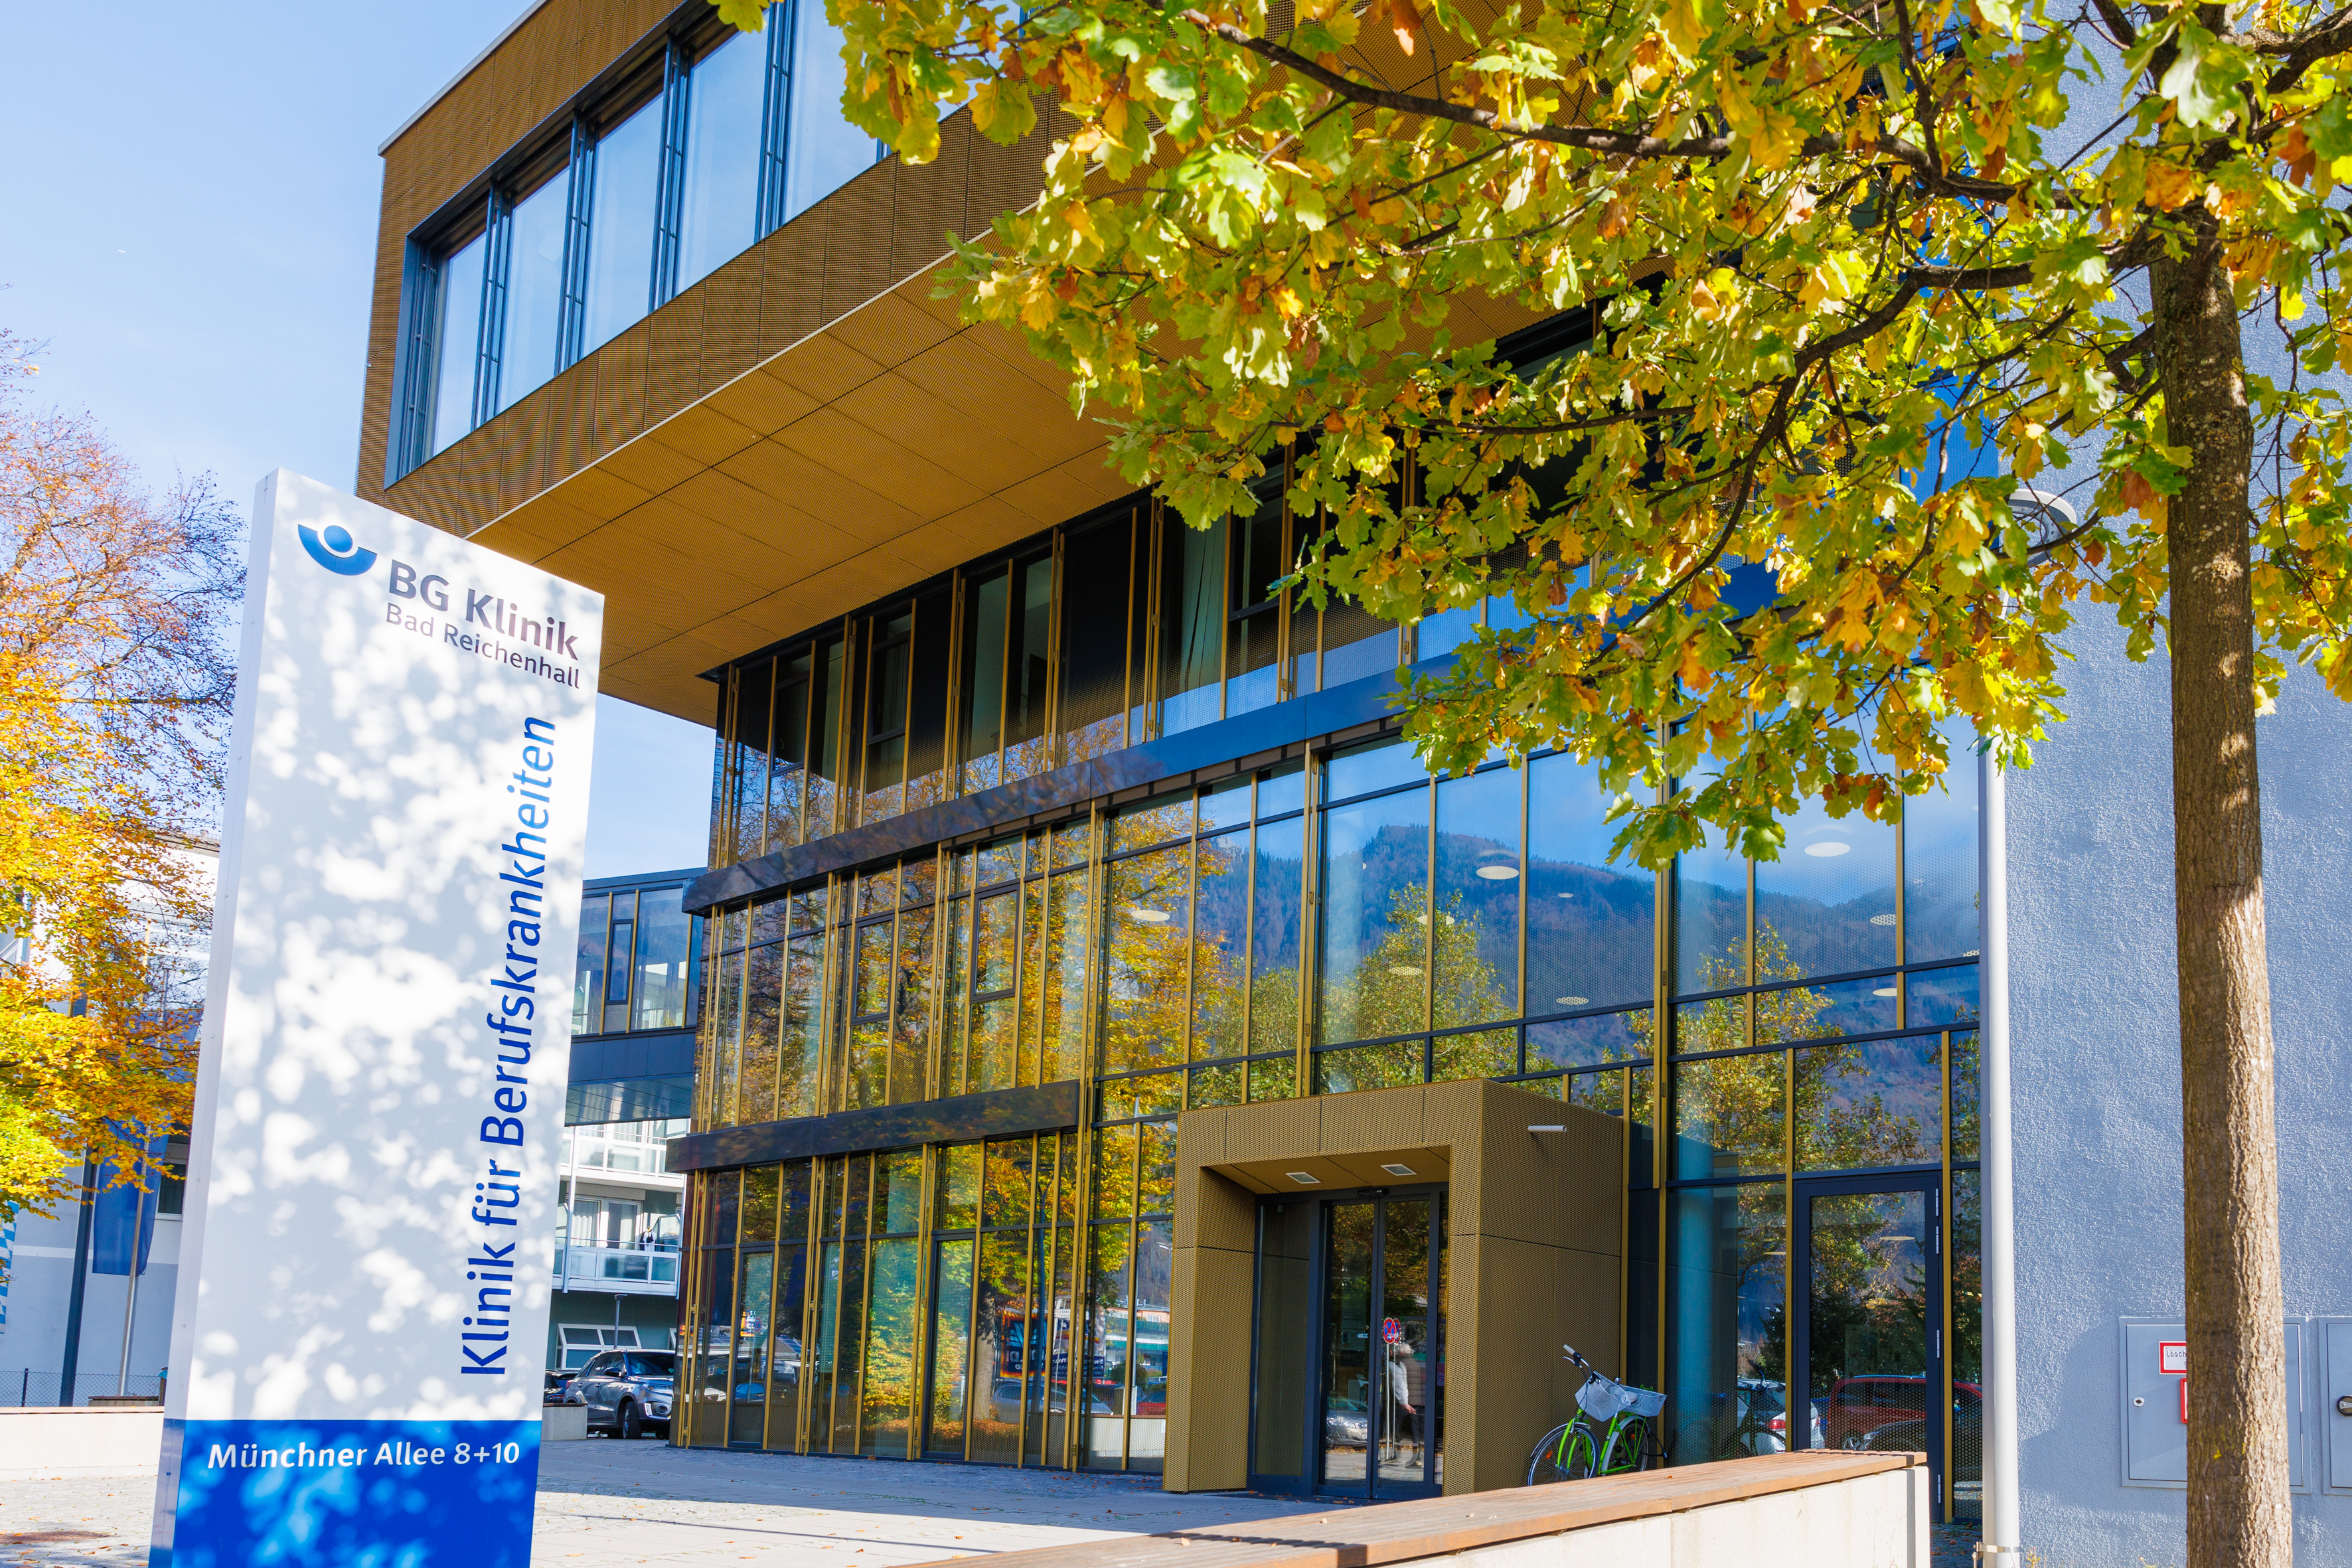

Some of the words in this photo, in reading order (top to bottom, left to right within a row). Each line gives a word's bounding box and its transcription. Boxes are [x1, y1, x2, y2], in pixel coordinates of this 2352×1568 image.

[386, 602, 434, 637] Bad
[443, 623, 580, 690] Reichenhall
[388, 559, 449, 611] BG
[465, 588, 579, 661] Klinik
[480, 716, 556, 1147] Berufskrankheiten
[471, 1158, 521, 1226] für
[461, 1241, 516, 1375] Klinik
[208, 1442, 368, 1469] Münchner
[374, 1441, 445, 1466] Allee
[453, 1442, 520, 1464] 8+10
